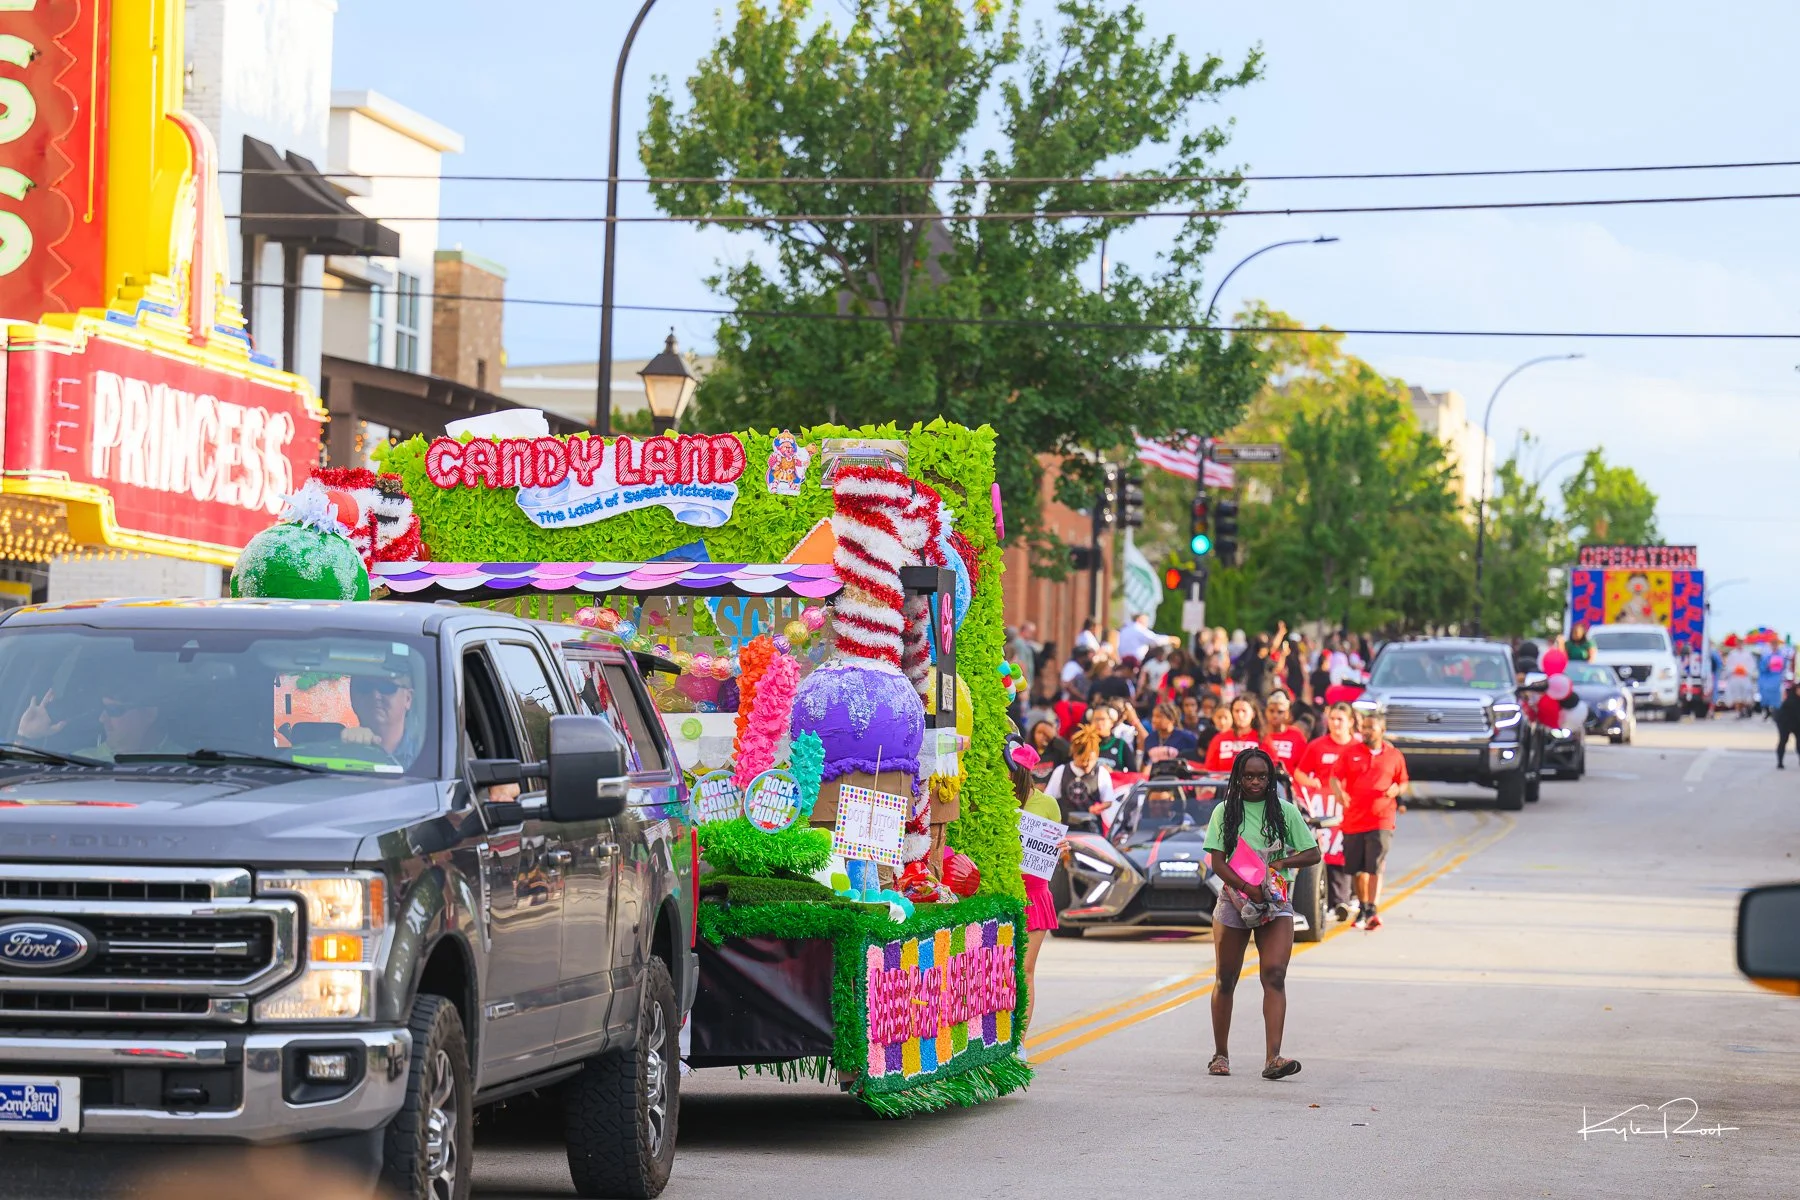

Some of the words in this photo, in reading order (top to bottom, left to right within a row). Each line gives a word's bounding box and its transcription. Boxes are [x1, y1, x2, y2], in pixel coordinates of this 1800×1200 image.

[91, 370, 294, 515] PRINCESS
[425, 435, 605, 489] CANDY
[615, 433, 747, 485] LAND
[536, 510, 566, 524] The
[568, 496, 603, 518] Land
[605, 492, 619, 508] of
[623, 484, 669, 503] Sweet
[669, 484, 734, 500] Victories
[1580, 546, 1696, 569] OPERATION
[763, 776, 795, 798] ROCK
[754, 790, 795, 812] CANDY
[752, 805, 789, 827] RIDGE
[847, 808, 865, 823] DOT
[4, 931, 62, 957] Ford
[25, 1085, 57, 1107] Perry
